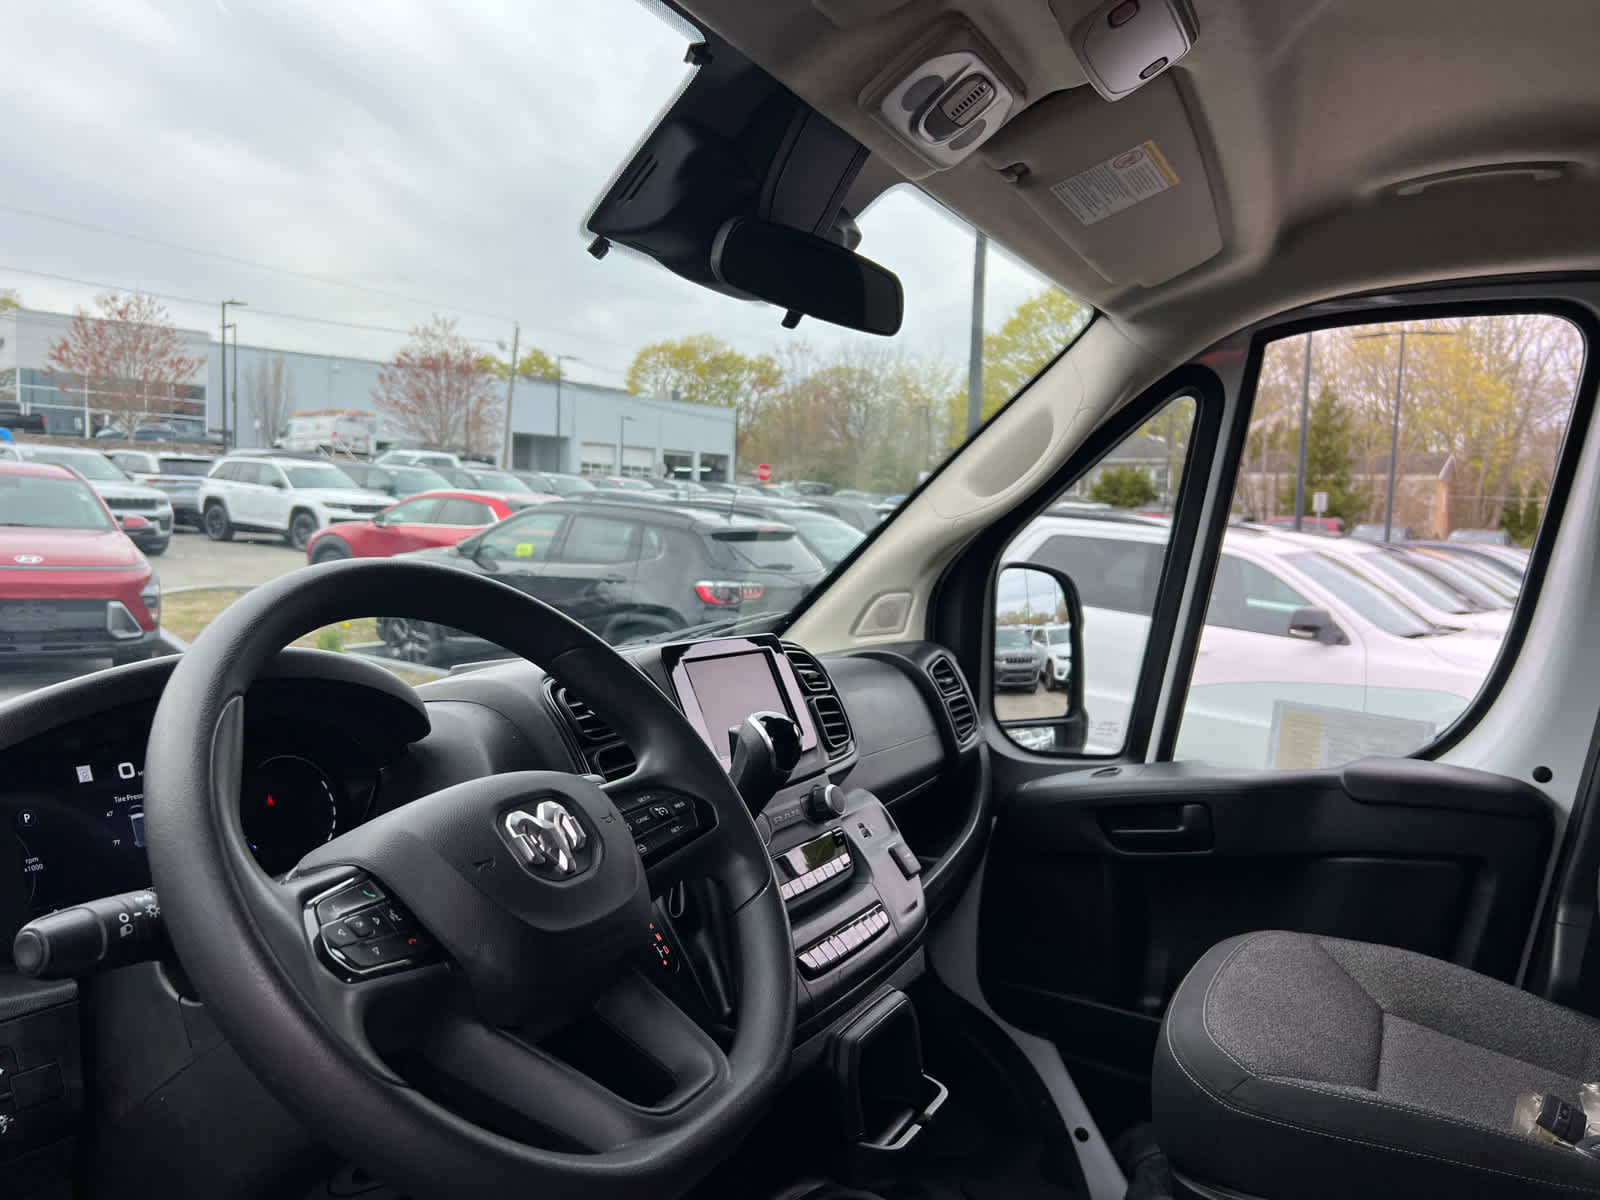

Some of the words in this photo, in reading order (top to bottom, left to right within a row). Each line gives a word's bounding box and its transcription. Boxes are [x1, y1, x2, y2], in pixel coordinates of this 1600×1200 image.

[118, 762, 135, 779] 0
[126, 793, 144, 801] Press
[23, 813, 31, 823] P
[25, 857, 39, 865] rpm
